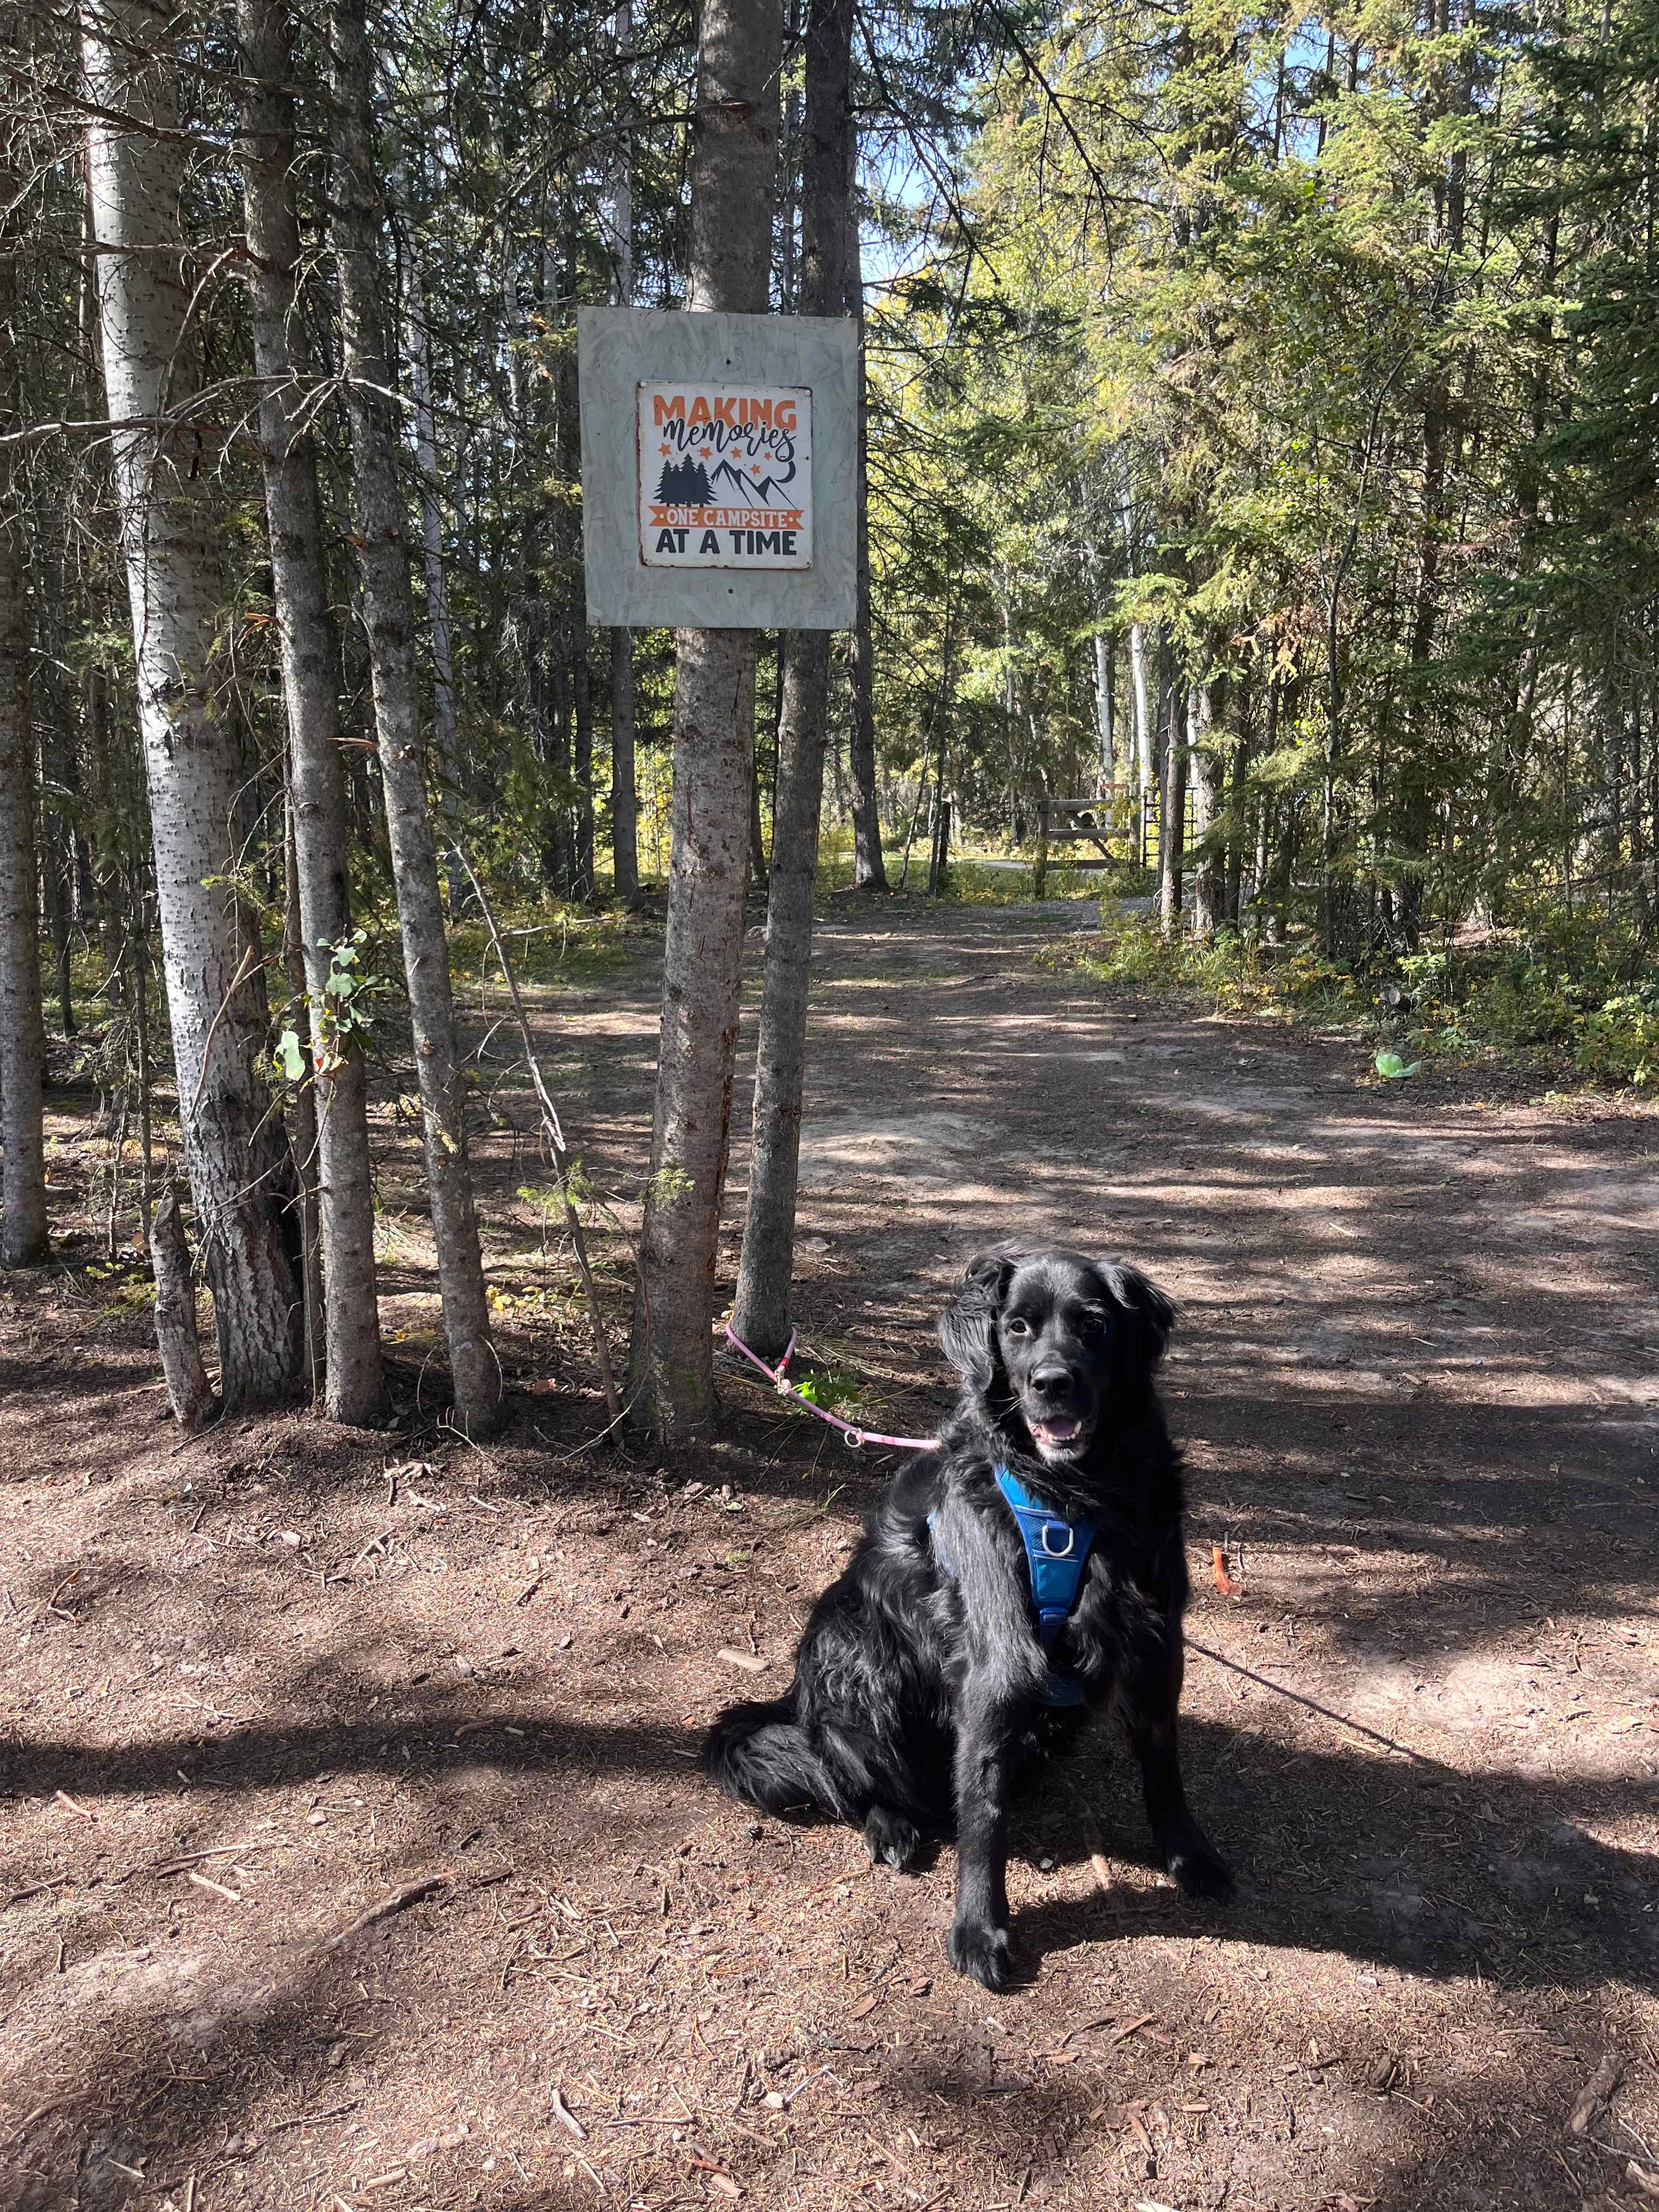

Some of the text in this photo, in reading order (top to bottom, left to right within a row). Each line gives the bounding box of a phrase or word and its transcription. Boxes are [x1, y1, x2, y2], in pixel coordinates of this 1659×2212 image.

[653, 395, 797, 431] MAKING
[667, 509, 788, 528] ONE CAMPSITE
[656, 528, 797, 555] AT A TIME
